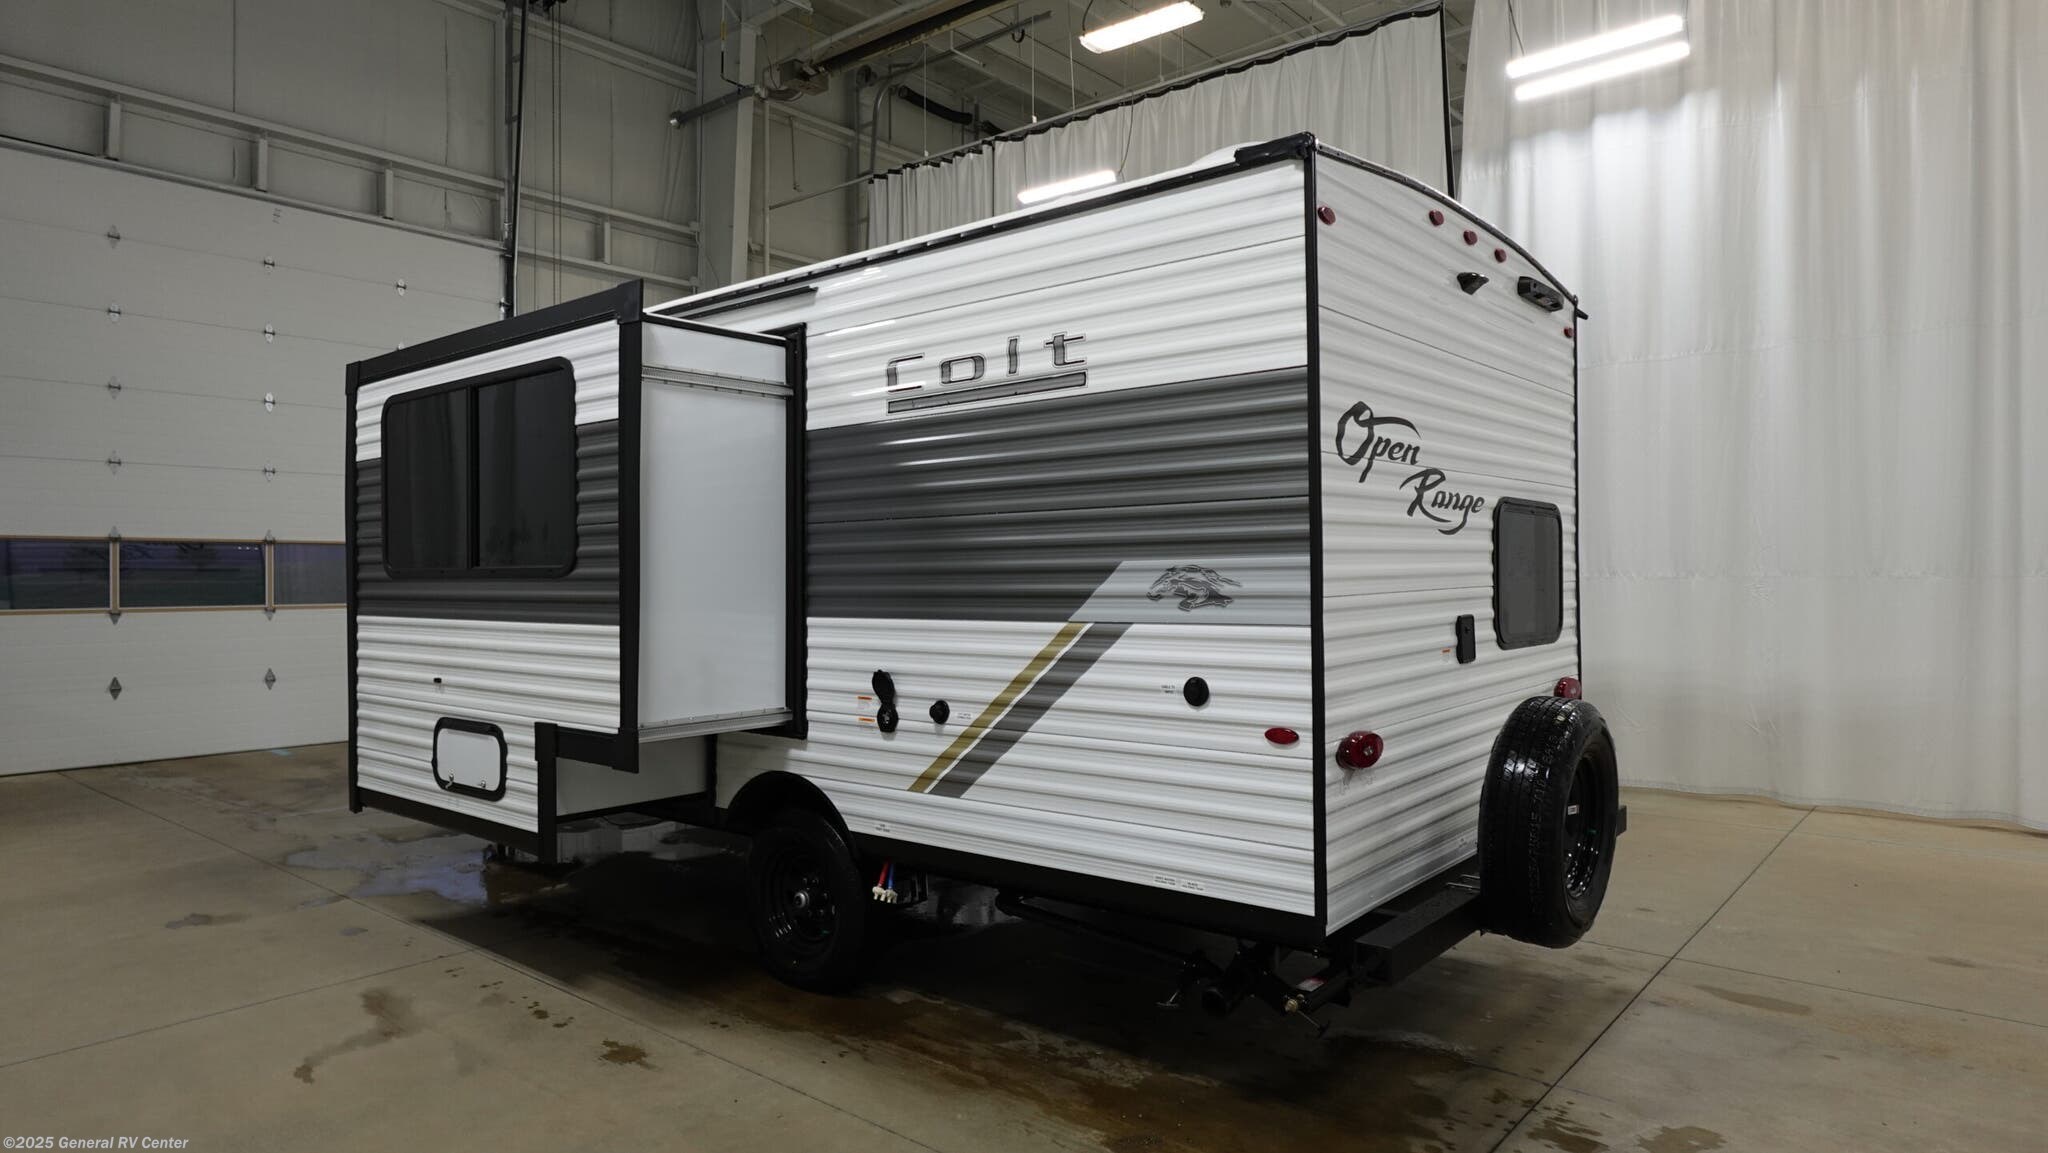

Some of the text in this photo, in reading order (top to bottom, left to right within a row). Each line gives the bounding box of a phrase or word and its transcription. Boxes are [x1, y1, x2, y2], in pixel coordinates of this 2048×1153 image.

[886, 331, 1087, 393] Colt
[1335, 400, 1423, 484] Open
[1399, 467, 1486, 536] Range
